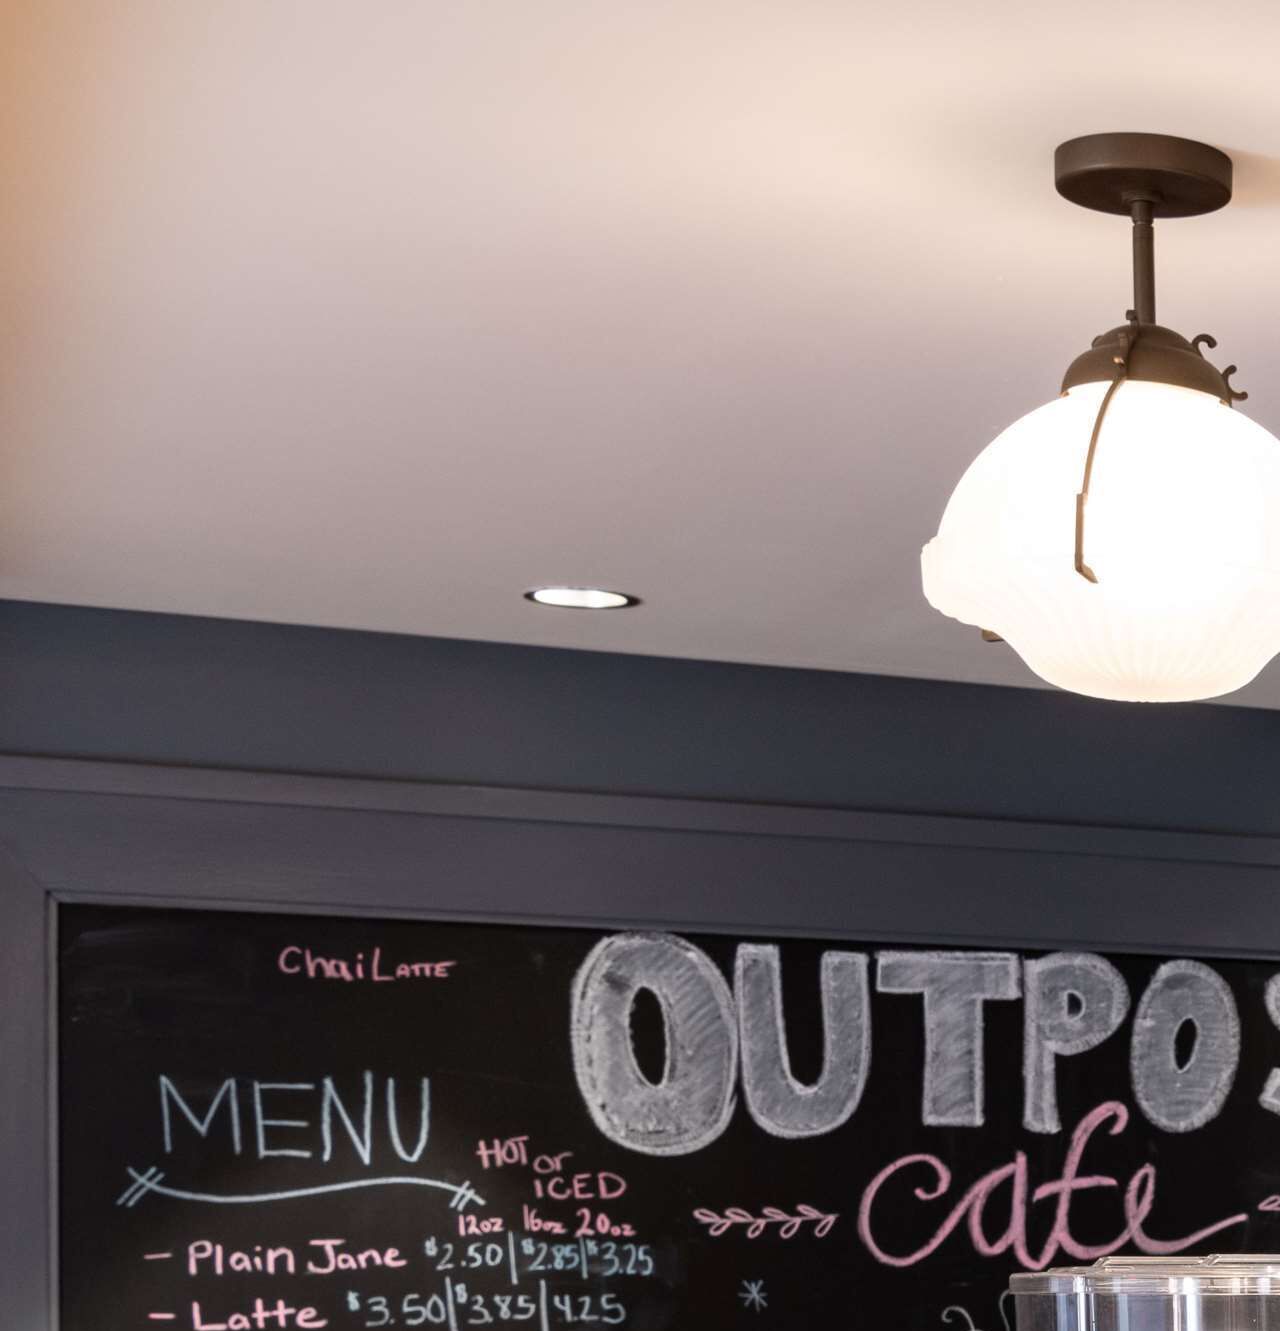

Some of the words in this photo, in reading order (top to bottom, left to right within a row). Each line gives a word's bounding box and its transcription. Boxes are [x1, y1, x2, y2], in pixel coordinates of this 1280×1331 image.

[160, 1070, 430, 1165] MENU
[475, 1135, 530, 1169] HOT
[533, 1152, 573, 1173] or
[534, 1172, 627, 1199] ICED
[458, 1214, 504, 1237] 12oz
[523, 1204, 567, 1234] 16oz
[574, 1207, 636, 1237] 20oz
[187, 1241, 297, 1274] Plain
[306, 1238, 408, 1274] Jane
[192, 1301, 328, 1331] Latte
